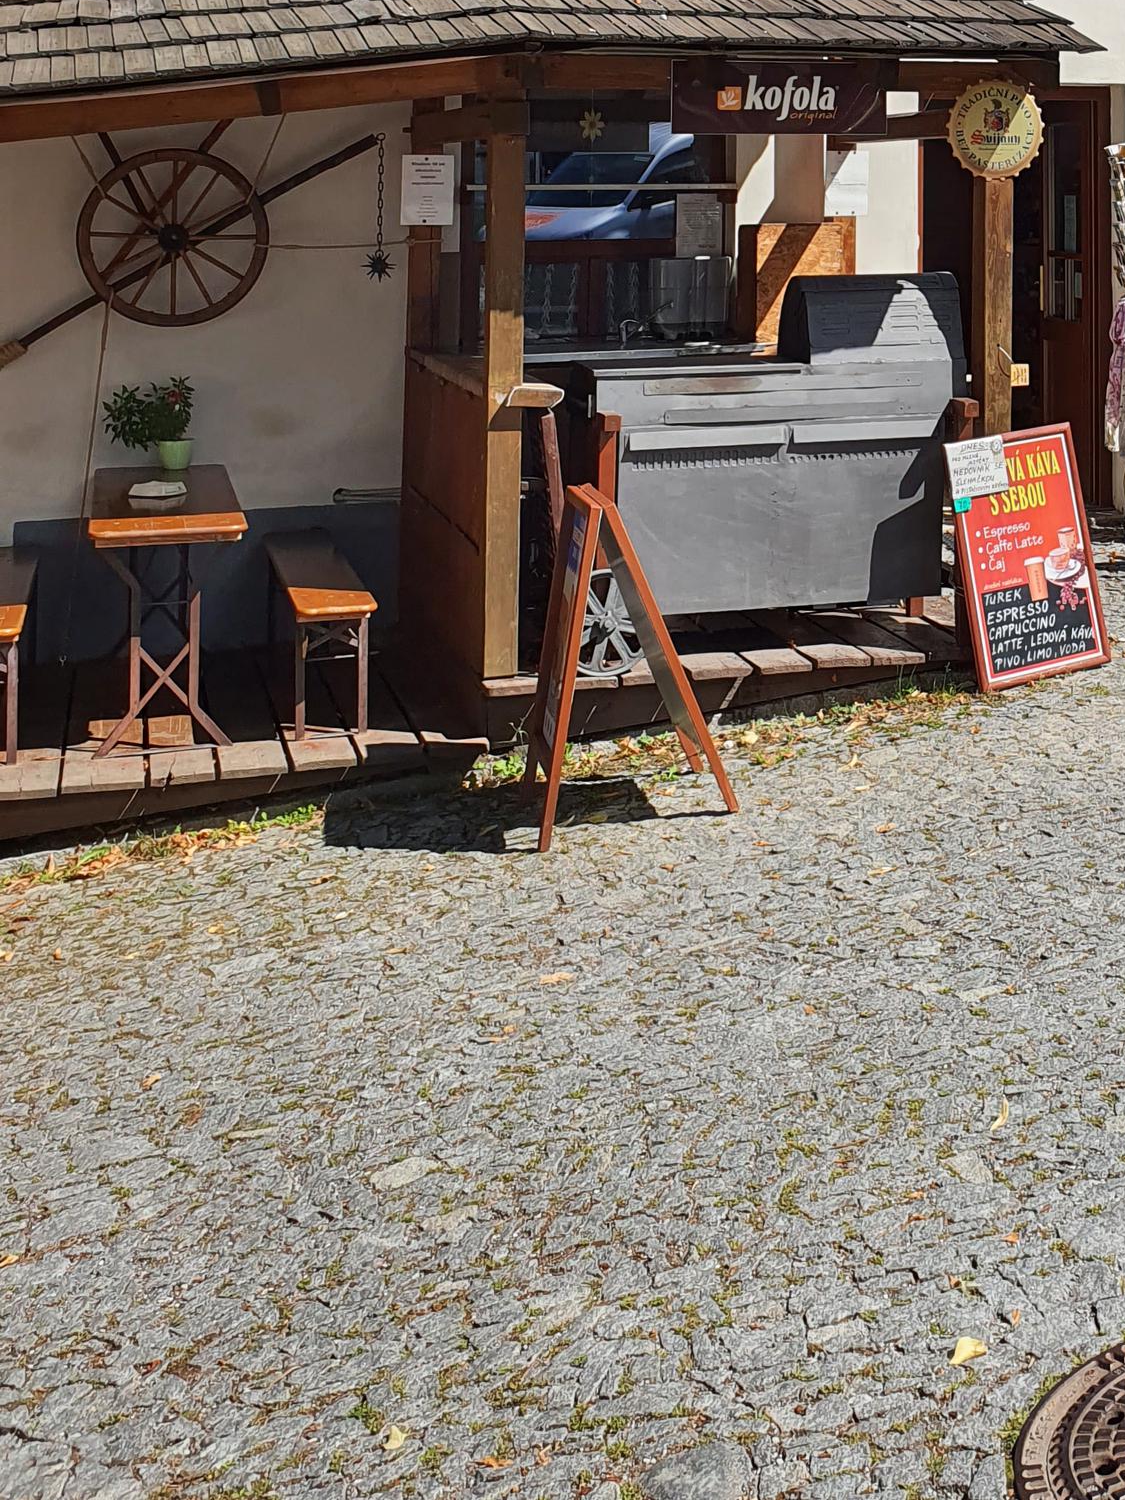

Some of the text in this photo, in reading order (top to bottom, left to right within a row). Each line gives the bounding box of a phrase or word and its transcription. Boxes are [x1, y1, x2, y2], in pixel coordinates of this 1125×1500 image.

[744, 75, 836, 121] kofola
[958, 87, 1032, 119] TRADIČNÍ PIVO
[790, 106, 838, 126] original
[956, 129, 1034, 170] BEZ PASTERIZACE
[970, 129, 1021, 146] Svijany
[1006, 446, 1061, 482] VÁ KÁVA
[988, 481, 1047, 516] S SEBOU
[983, 522, 1031, 541] Espresso
[986, 536, 1044, 555] Caffe Latte
[988, 554, 1006, 573] Čaj
[987, 600, 1049, 625] ESPRESSO
[989, 614, 1056, 640] CAPPUCCINO
[1030, 624, 1069, 648] LEDOVÁ
[1071, 624, 1096, 640] KÁVA
[1059, 640, 1087, 656] VODA
